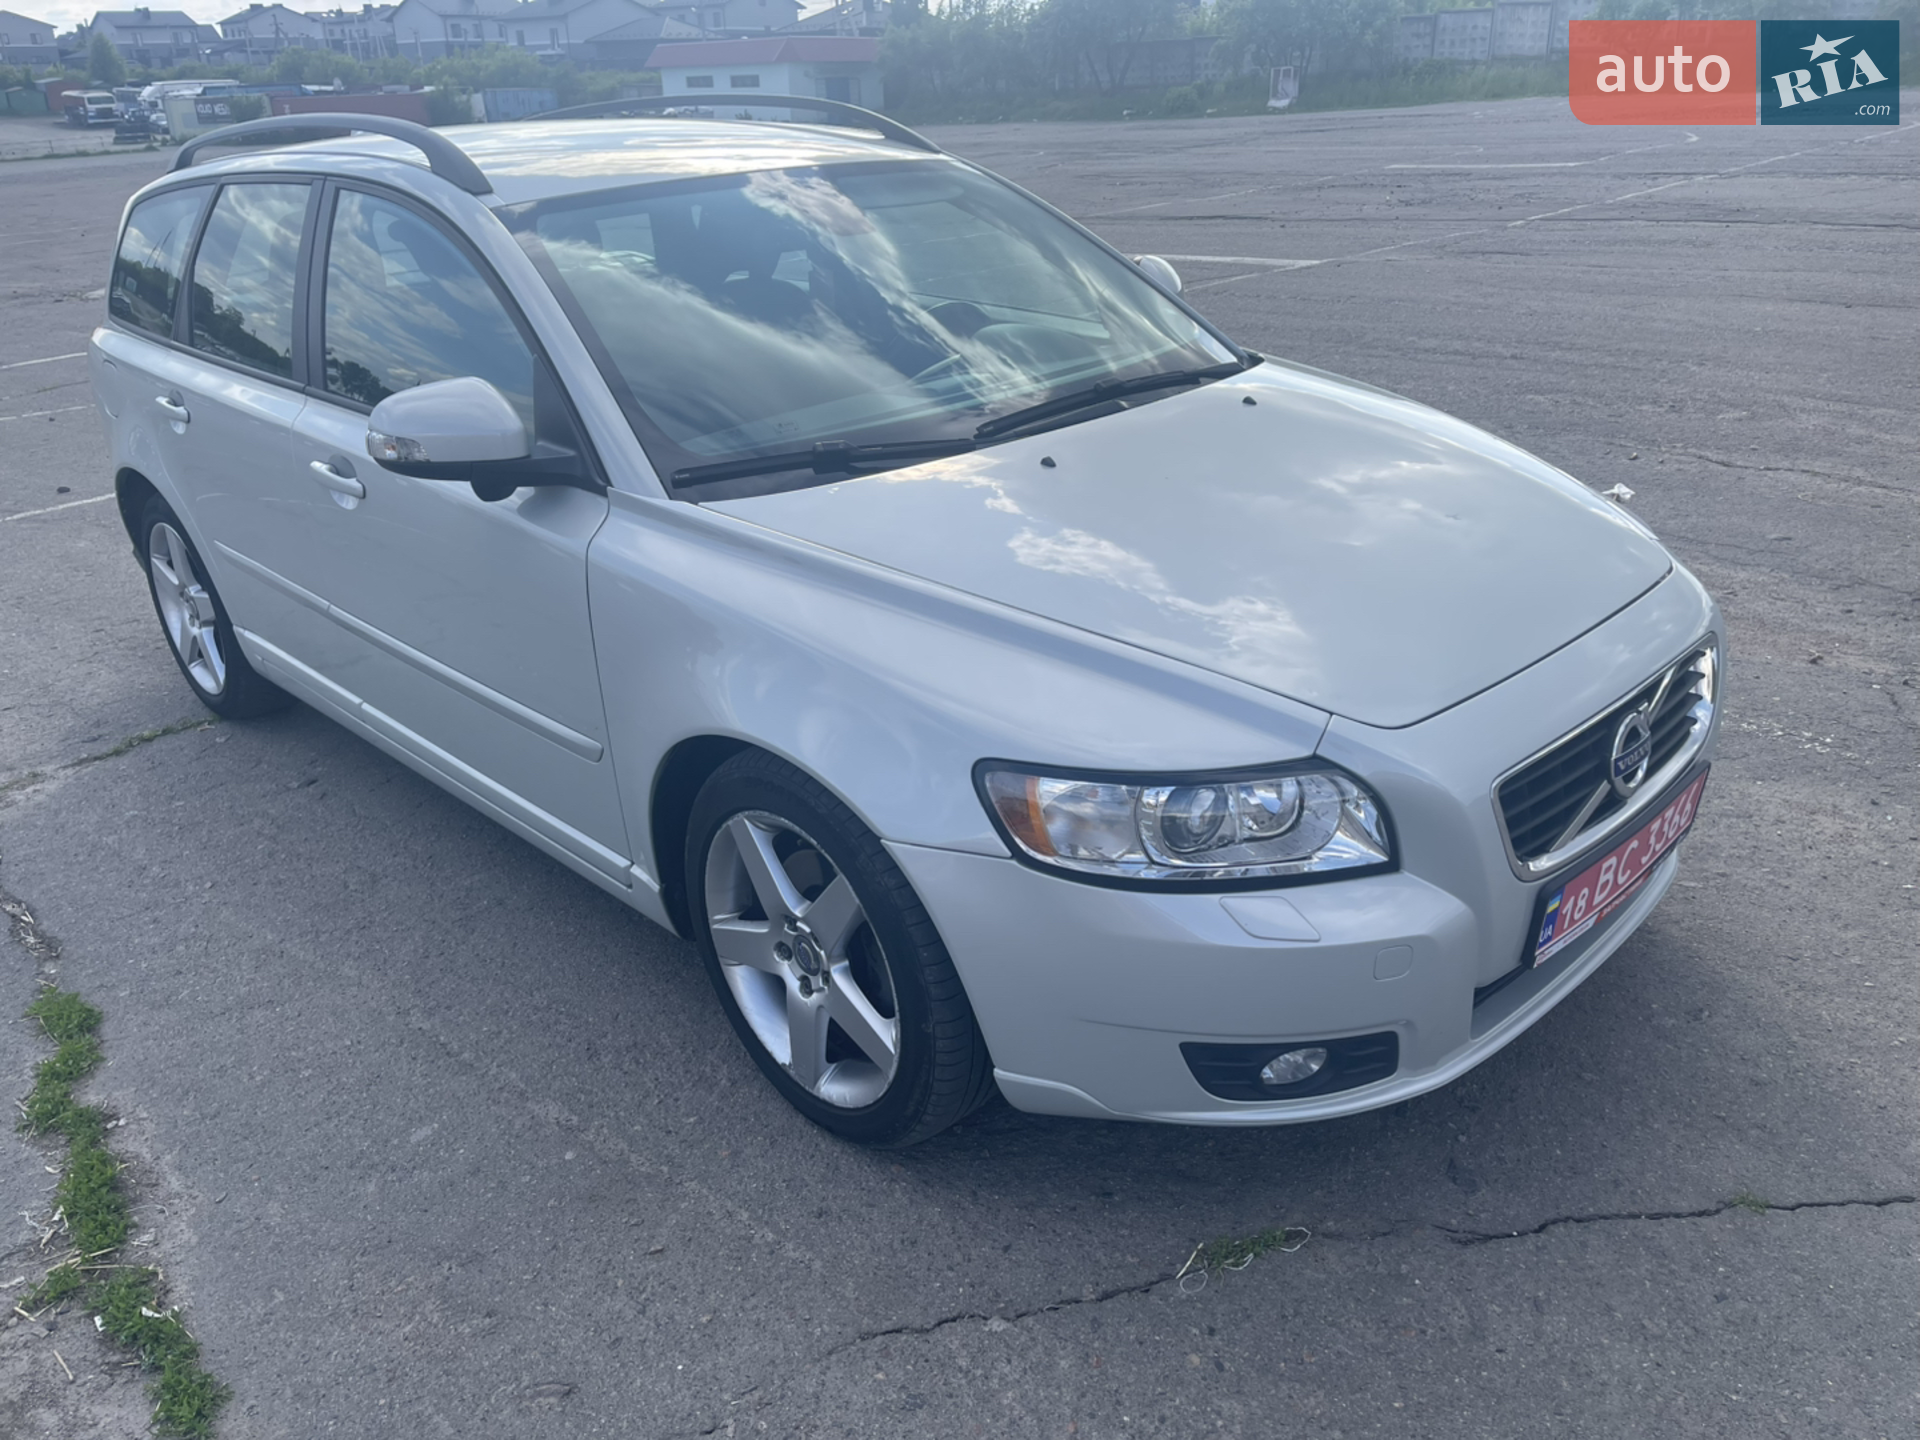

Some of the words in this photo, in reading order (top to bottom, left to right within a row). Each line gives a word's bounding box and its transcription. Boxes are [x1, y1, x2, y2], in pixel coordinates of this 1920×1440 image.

[1562, 887, 1589, 931] 18
[1592, 839, 1639, 907] BC
[1641, 782, 1699, 865] 3366
